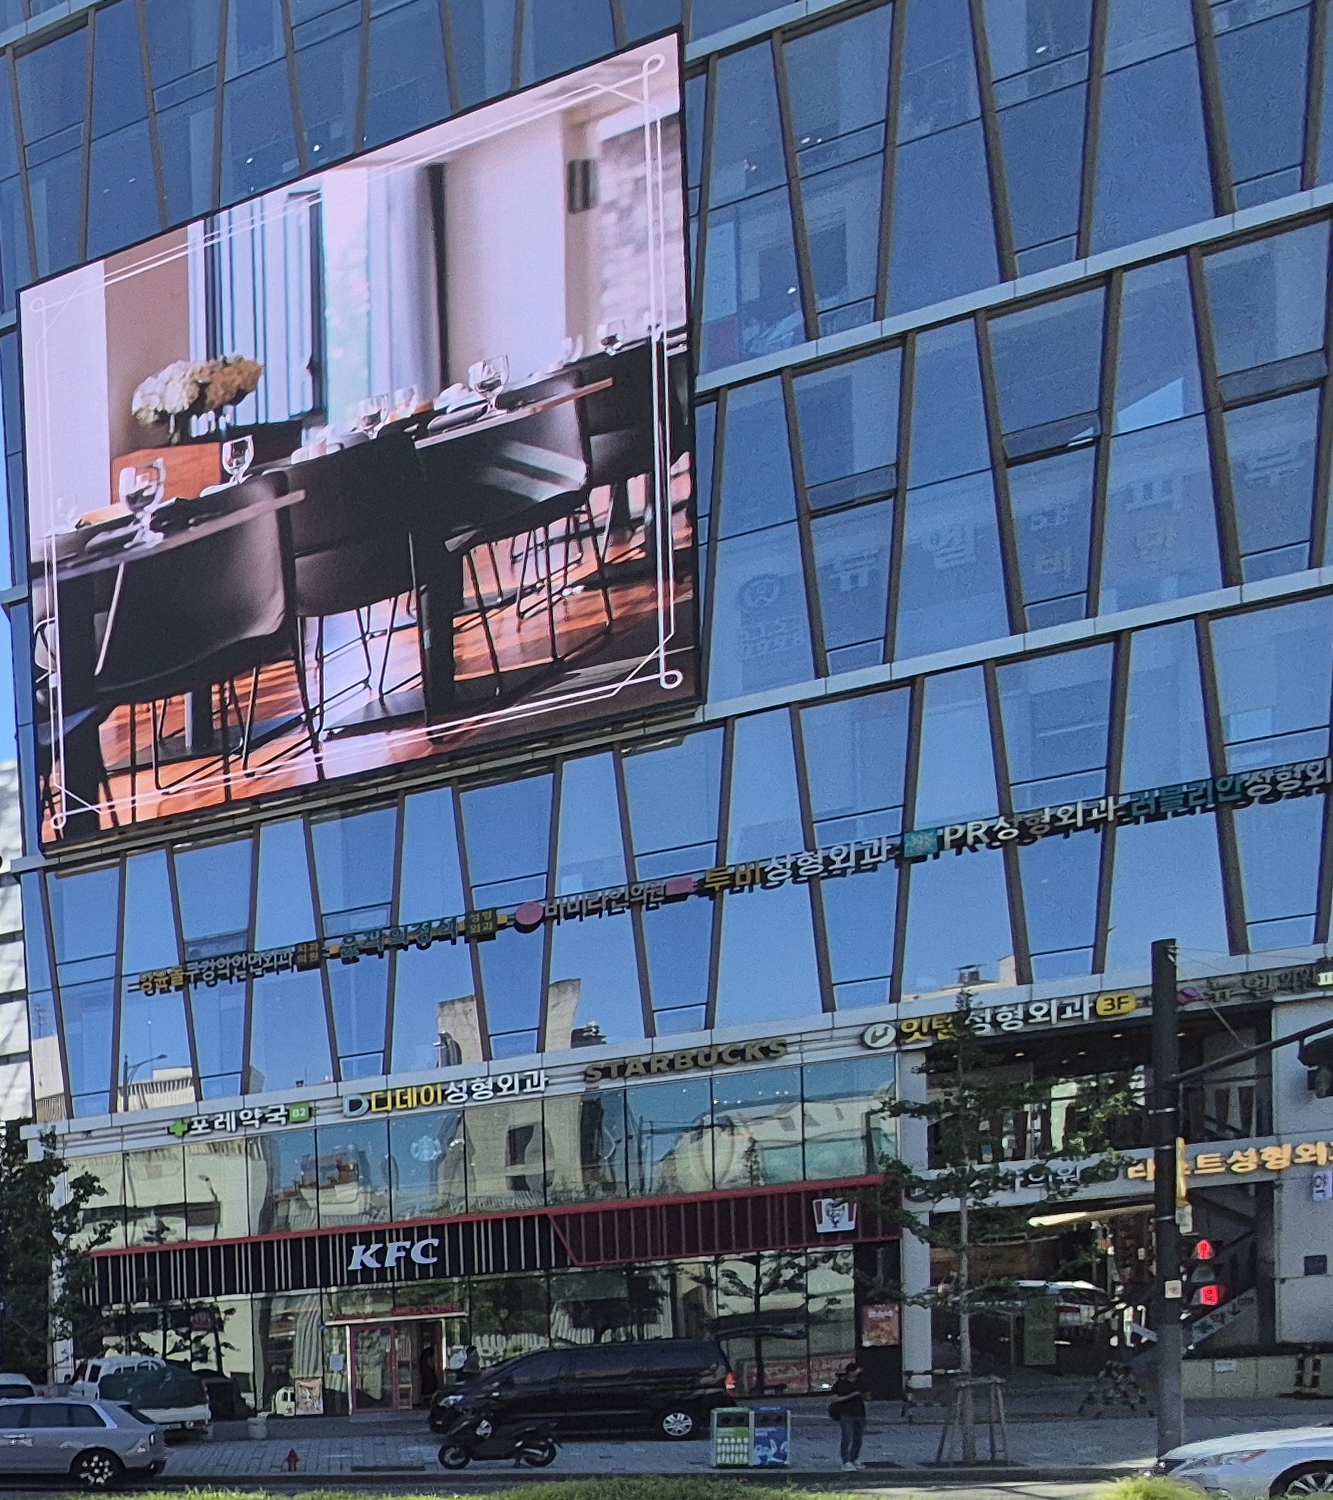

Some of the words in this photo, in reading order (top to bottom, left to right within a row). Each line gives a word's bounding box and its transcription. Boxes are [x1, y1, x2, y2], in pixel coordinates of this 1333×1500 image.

[1102, 995, 1131, 1013] 3F
[583, 1038, 788, 1084] STARBUCKS
[370, 1070, 549, 1113] 디데이성형외과
[189, 1104, 289, 1137] 포레약국
[347, 1237, 440, 1271] KFC
